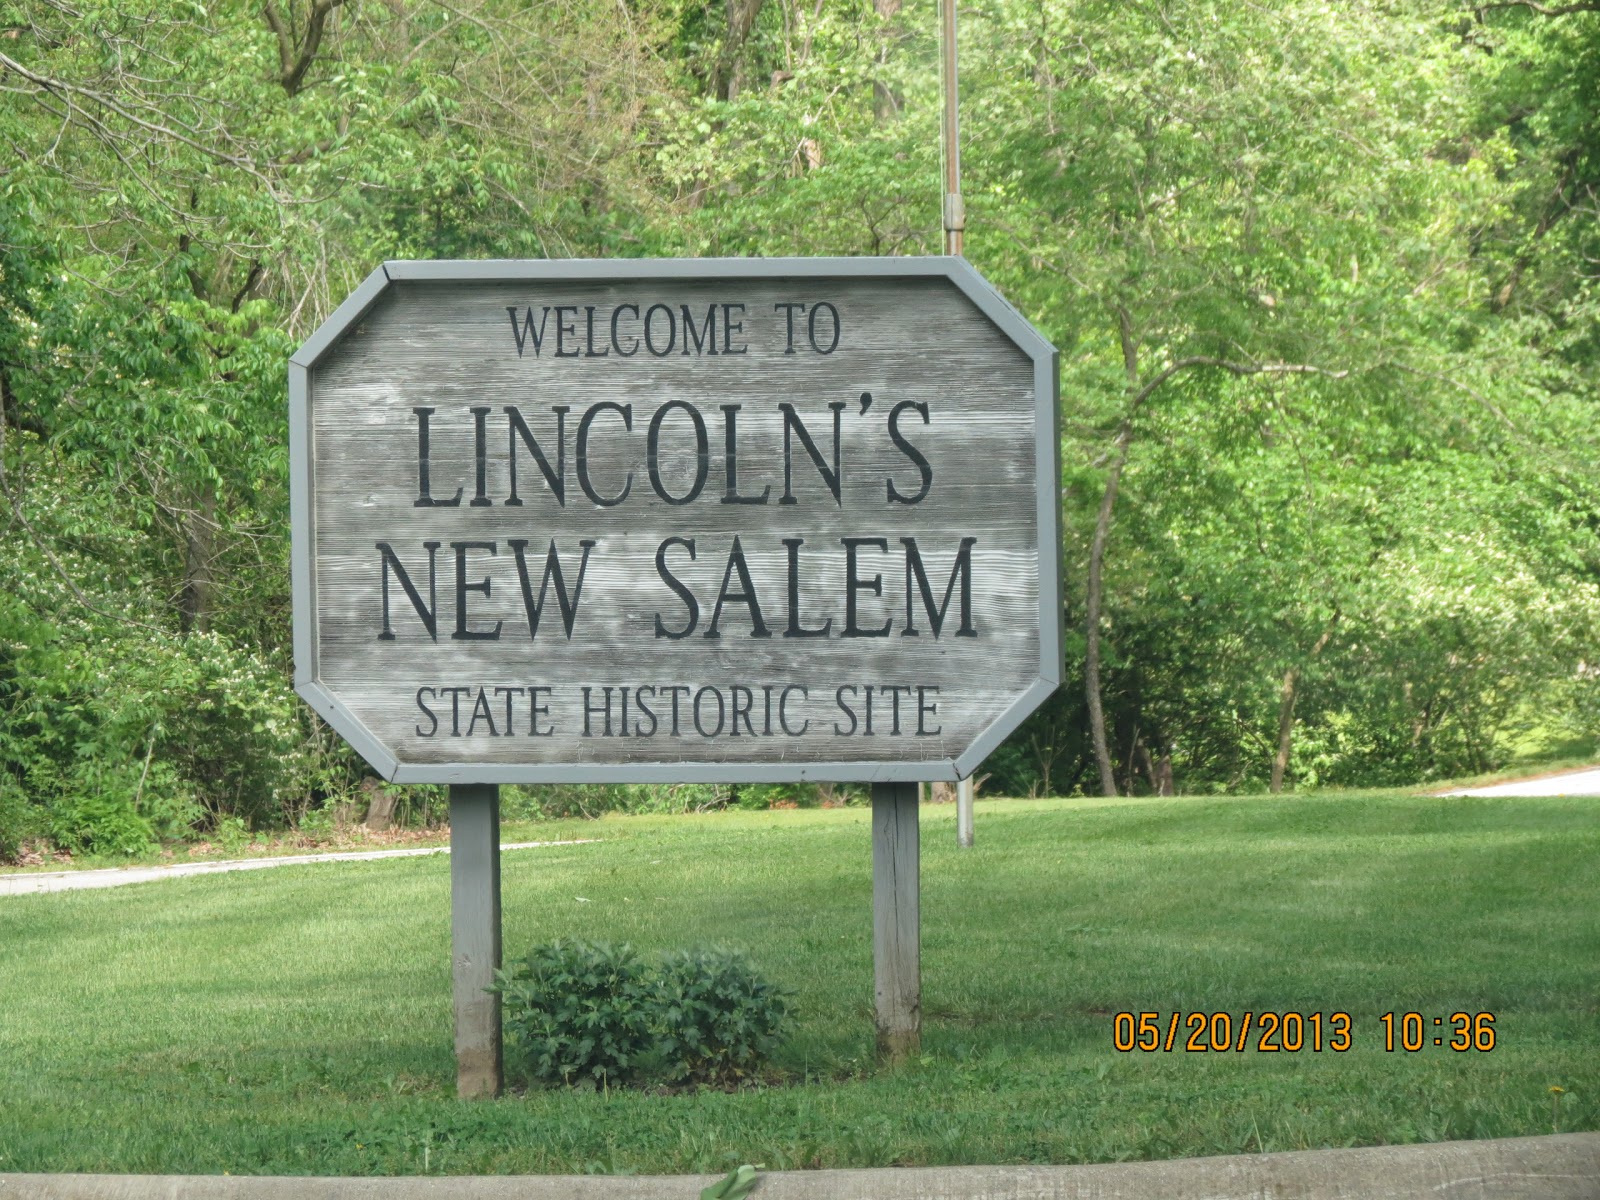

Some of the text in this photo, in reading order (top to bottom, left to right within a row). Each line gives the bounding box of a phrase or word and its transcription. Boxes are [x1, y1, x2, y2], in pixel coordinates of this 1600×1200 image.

[507, 302, 841, 358] WELCOME TO
[412, 392, 933, 508] LINCOLN'S
[375, 535, 978, 642] NEW SALEM
[415, 685, 942, 738] STATE HISTORIC SITE
